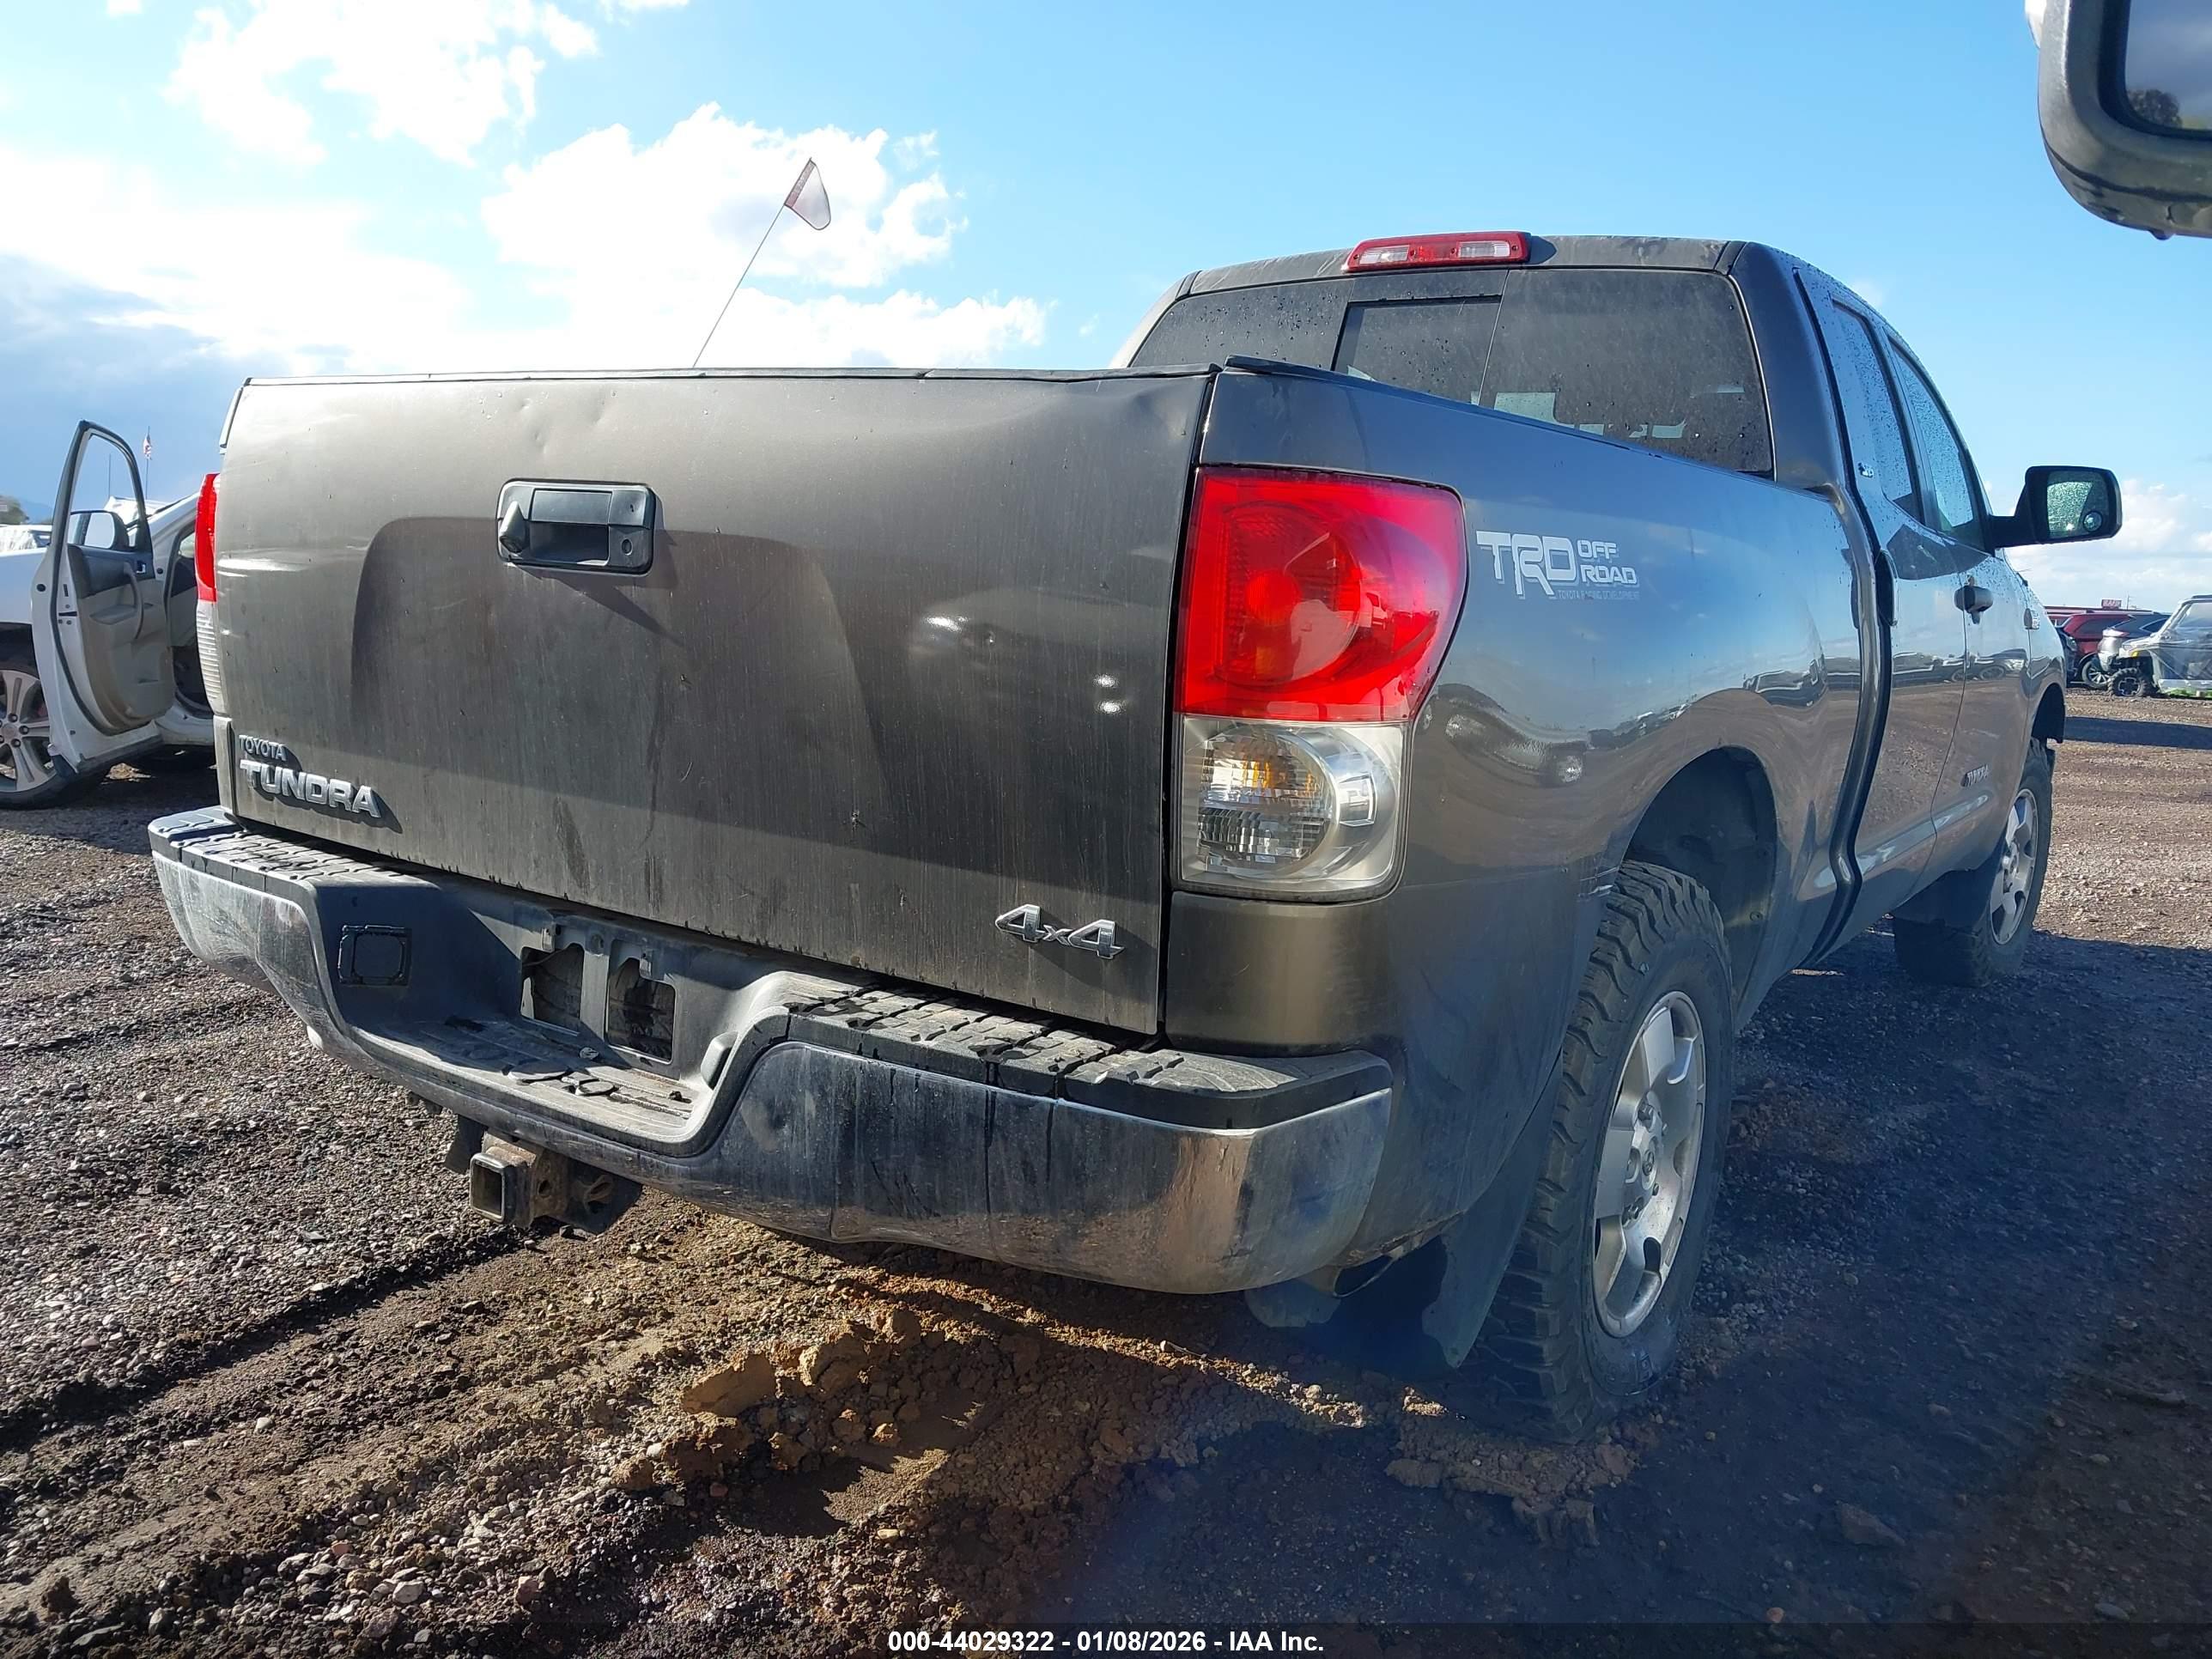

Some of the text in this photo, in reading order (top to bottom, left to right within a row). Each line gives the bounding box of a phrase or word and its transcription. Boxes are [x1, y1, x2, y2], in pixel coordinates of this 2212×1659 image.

[1475, 531, 1577, 596] TRD
[1577, 539, 1618, 560] OFF
[1579, 564, 1638, 585] ROAD
[238, 734, 287, 762] TOYOTA
[239, 758, 382, 818] TUNDRA
